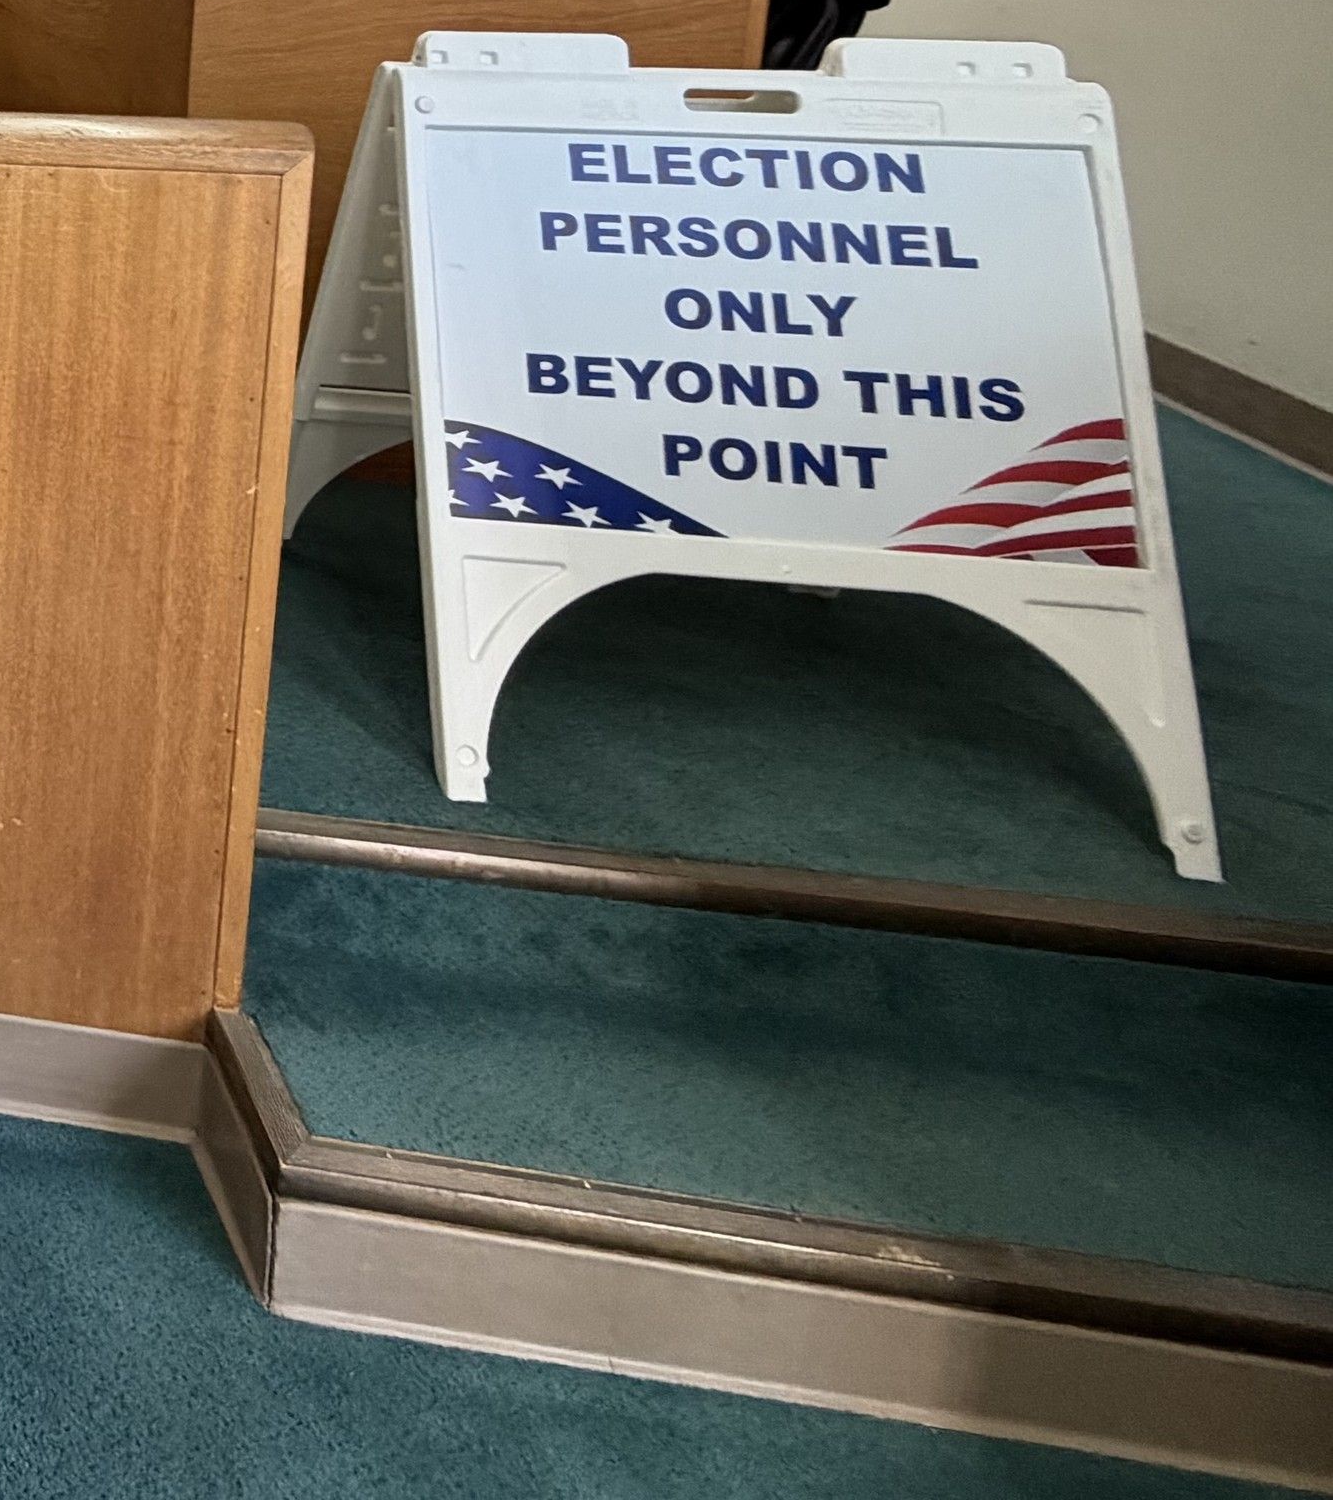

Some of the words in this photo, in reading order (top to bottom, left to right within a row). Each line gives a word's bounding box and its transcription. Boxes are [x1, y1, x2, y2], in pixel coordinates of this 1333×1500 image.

[568, 143, 926, 194] ELECTION
[539, 212, 979, 269] PERSONNEL
[663, 288, 857, 338] ONLY
[526, 353, 819, 410] BEYOND
[844, 371, 1025, 422] THIS
[662, 434, 889, 490] POINT
